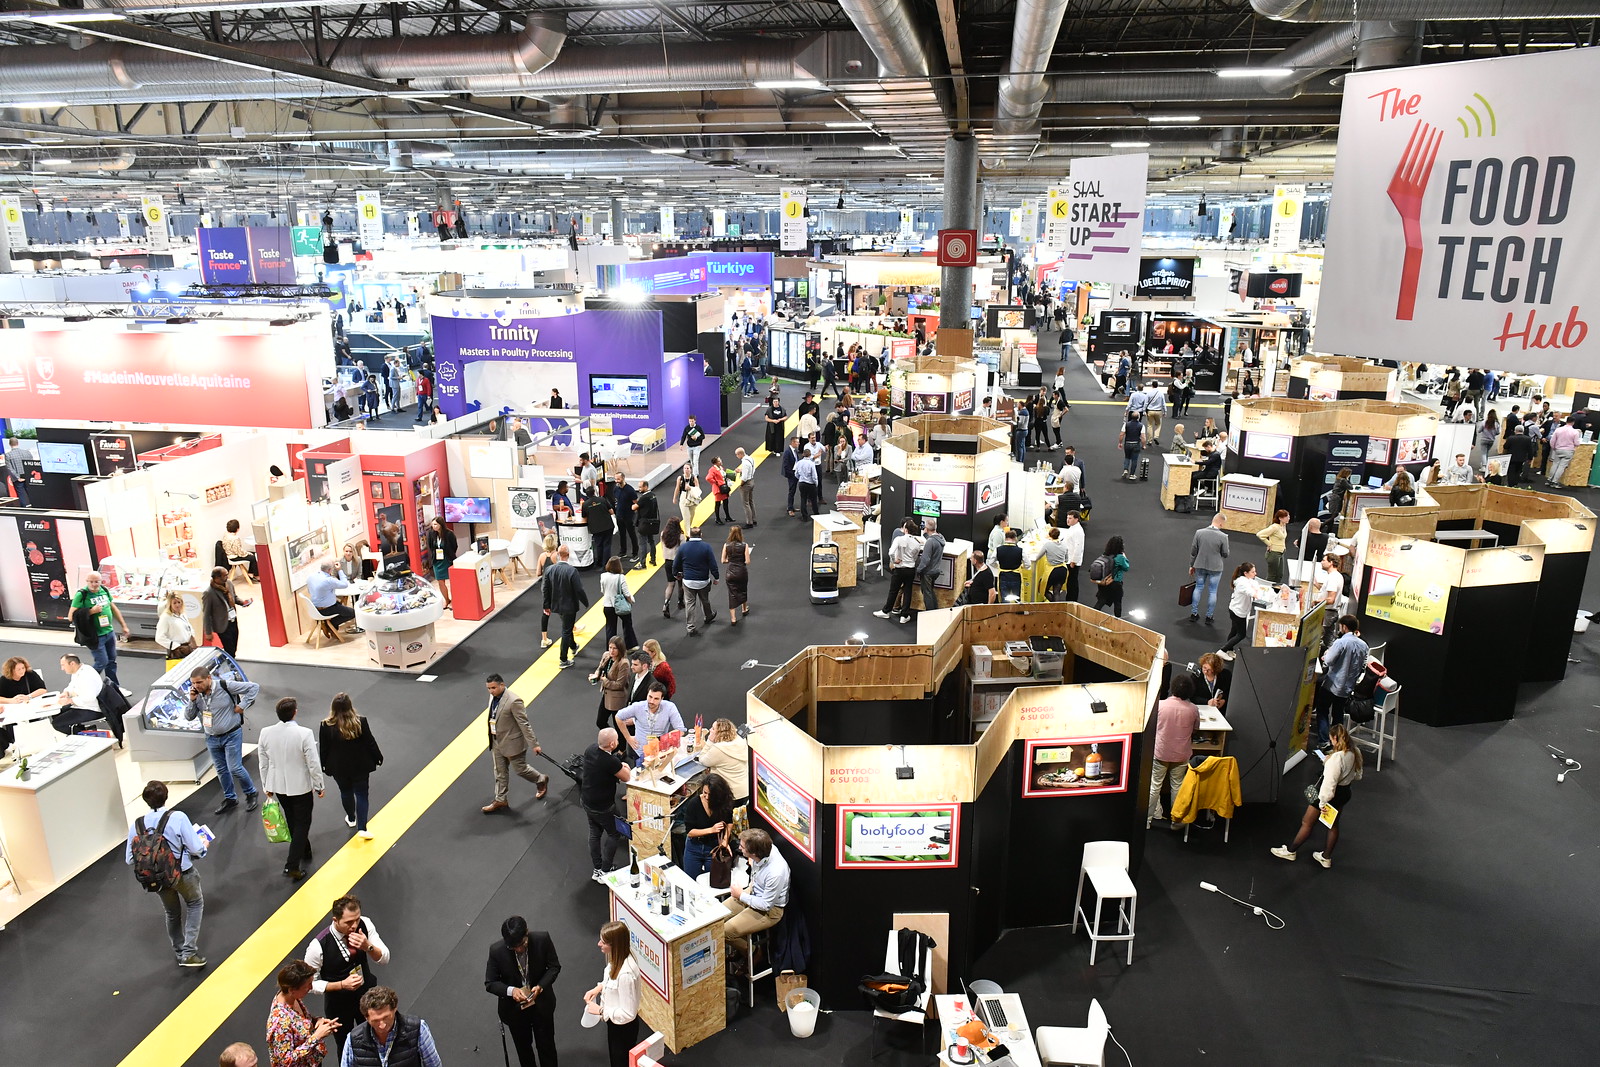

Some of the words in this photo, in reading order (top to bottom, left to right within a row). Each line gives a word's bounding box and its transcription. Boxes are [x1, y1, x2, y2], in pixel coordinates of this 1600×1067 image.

[1368, 88, 1421, 121] The
[1073, 180, 1104, 198] SIAL
[1441, 156, 1576, 226] FOOD
[9, 210, 15, 221] F
[149, 208, 159, 220] G
[365, 205, 374, 216] H
[790, 203, 796, 216] J
[1056, 203, 1066, 215] K
[1071, 202, 1121, 222] START
[1284, 202, 1290, 215] L
[1070, 227, 1092, 246] UP
[208, 249, 234, 260] Taste
[258, 248, 280, 259] Taste
[707, 261, 755, 277] Türkiye
[1438, 236, 1563, 304] TECH
[489, 324, 539, 345] Trinity
[1493, 305, 1588, 352] Hub
[459, 347, 490, 357] Masters
[492, 347, 500, 357] in
[501, 348, 529, 359] Poultry
[531, 348, 573, 360] Processing
[83, 370, 251, 390] #MadeinNouvelleAquitaine
[446, 385, 459, 393] IFS
[860, 823, 925, 838] biotyfood
